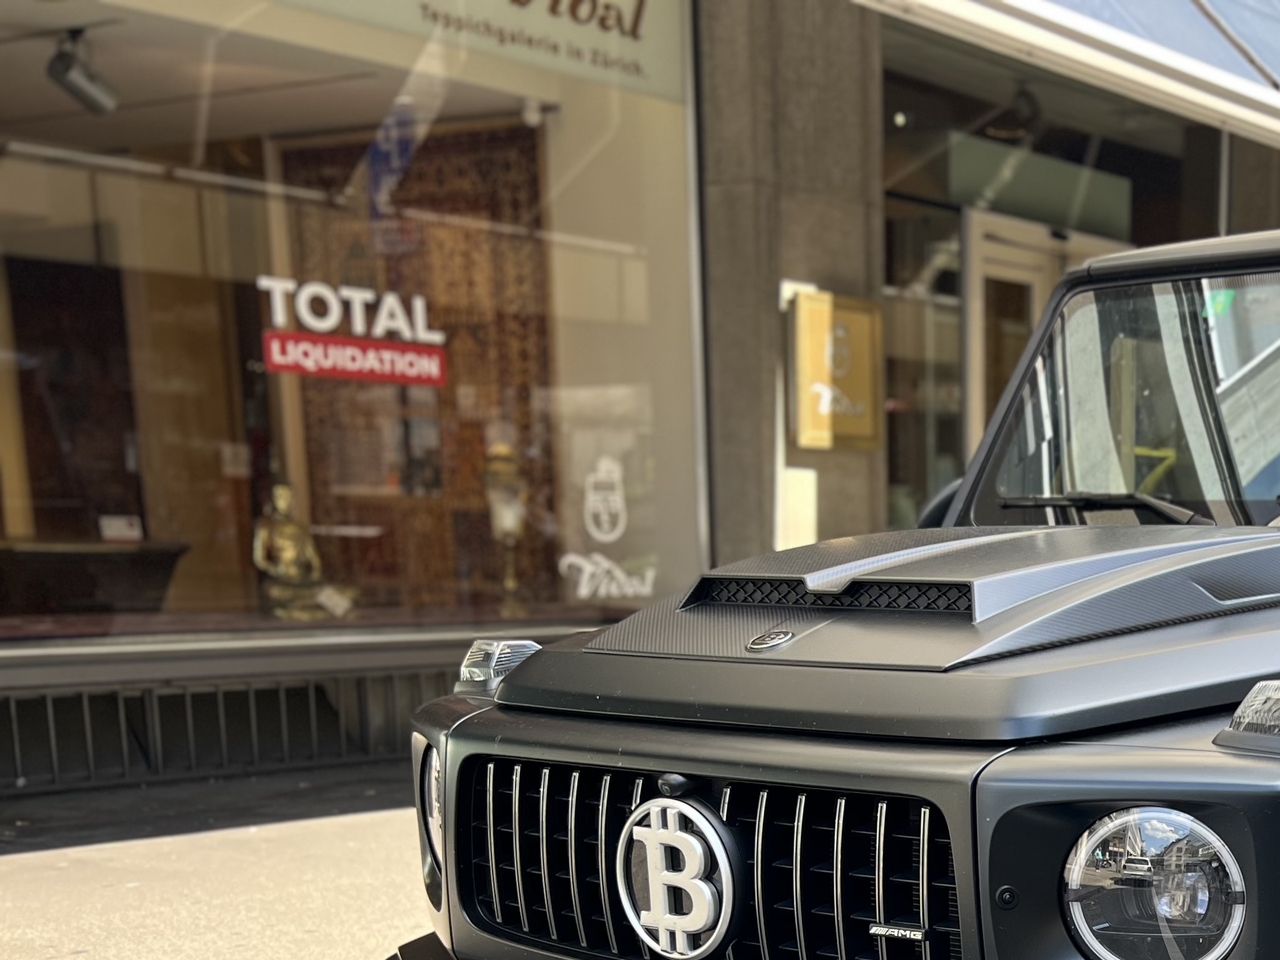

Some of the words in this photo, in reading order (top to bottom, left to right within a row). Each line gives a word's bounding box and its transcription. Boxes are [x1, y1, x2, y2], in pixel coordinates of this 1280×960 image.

[256, 274, 447, 346] TOTAL
[269, 338, 442, 380] LIQUIDATION
[557, 551, 657, 600] Vidal
[885, 928, 923, 940] AMG
